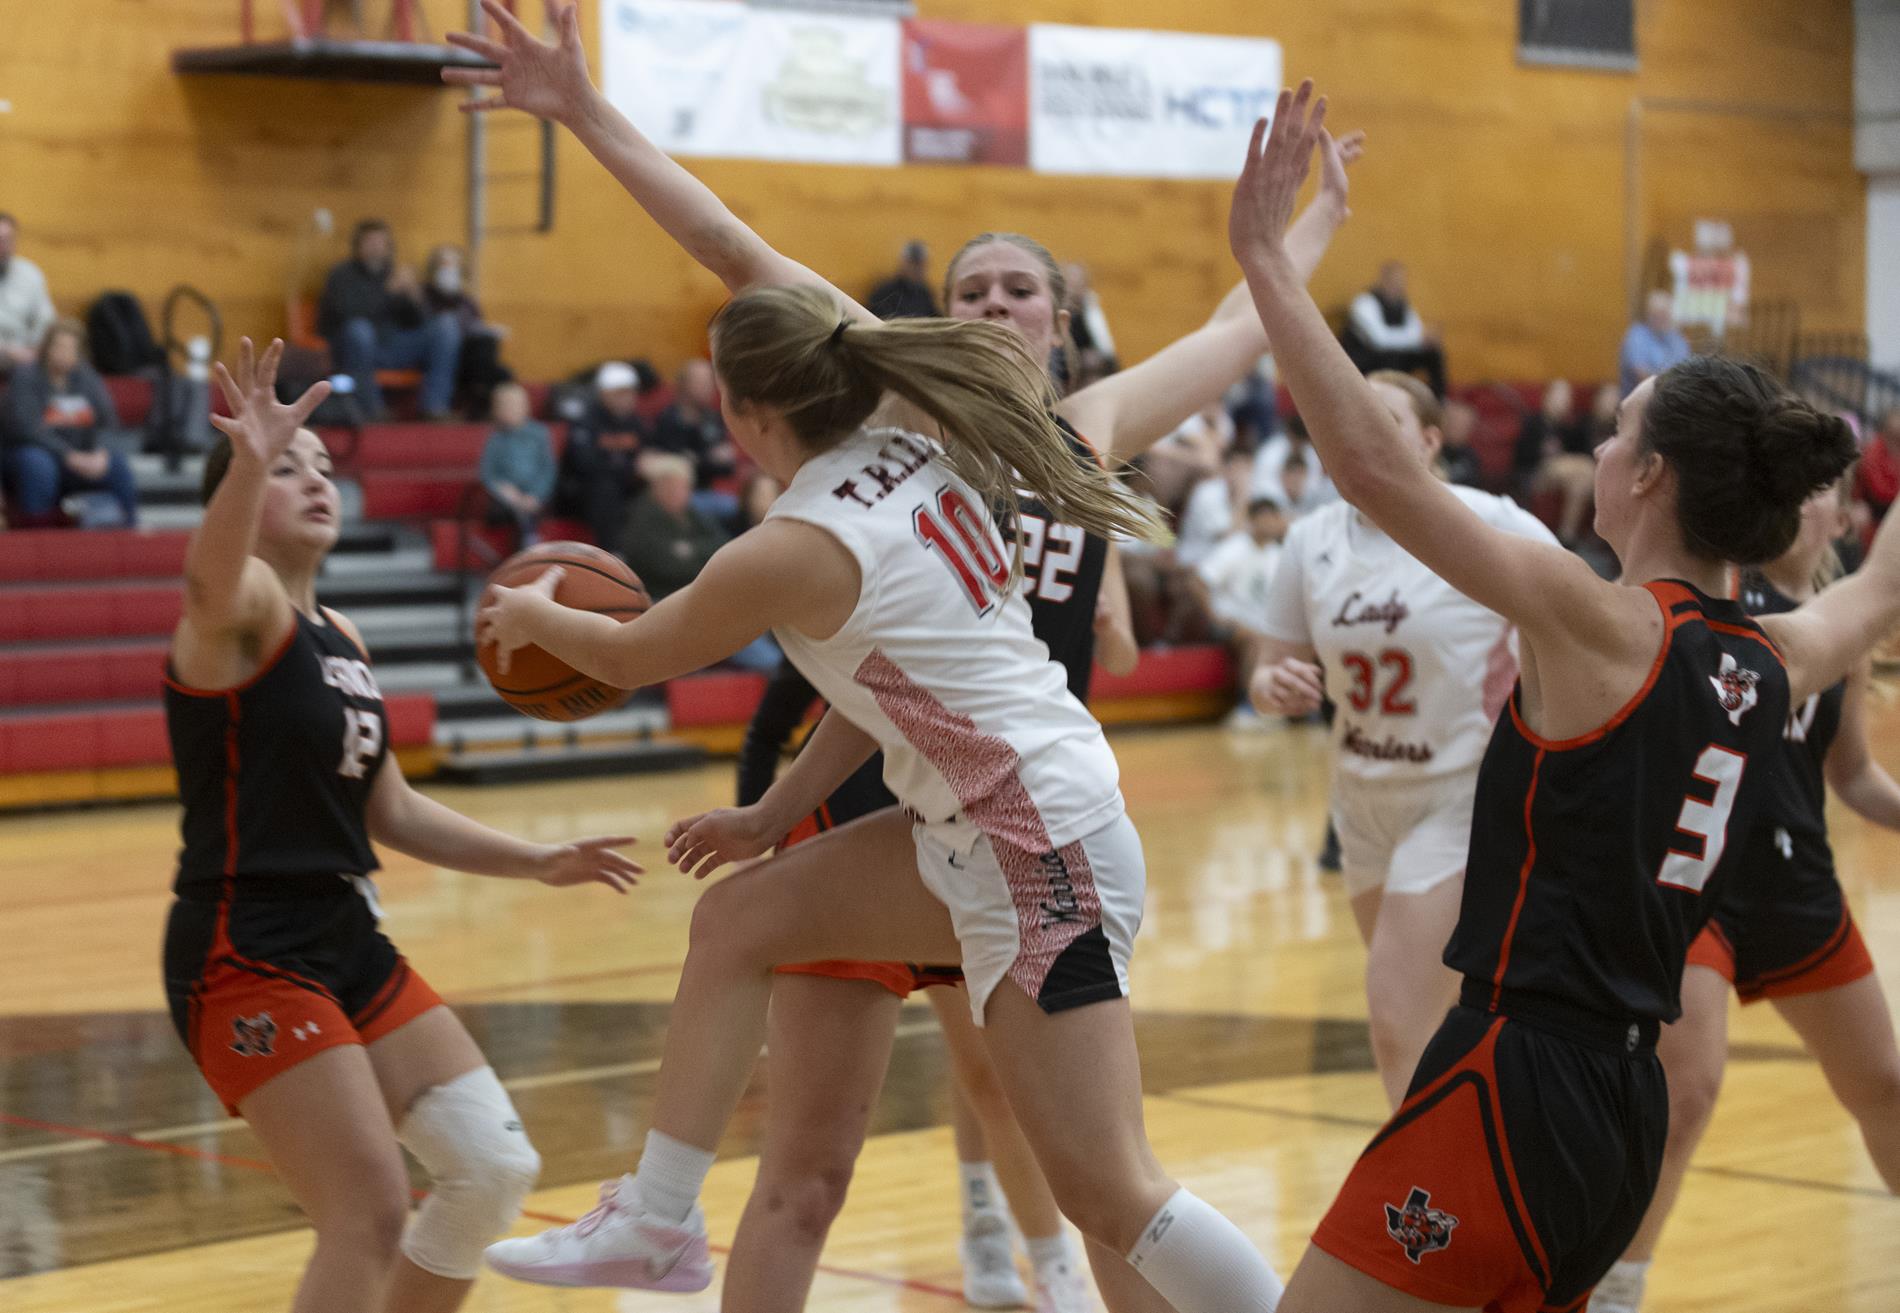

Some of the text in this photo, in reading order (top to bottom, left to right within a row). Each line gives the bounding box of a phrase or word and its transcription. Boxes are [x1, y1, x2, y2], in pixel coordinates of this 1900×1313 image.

[912, 483, 1010, 619] 10
[1007, 513, 1085, 603] 22
[1332, 588, 1409, 634] Lady
[1342, 648, 1416, 715] 32
[1656, 743, 1747, 896] 3
